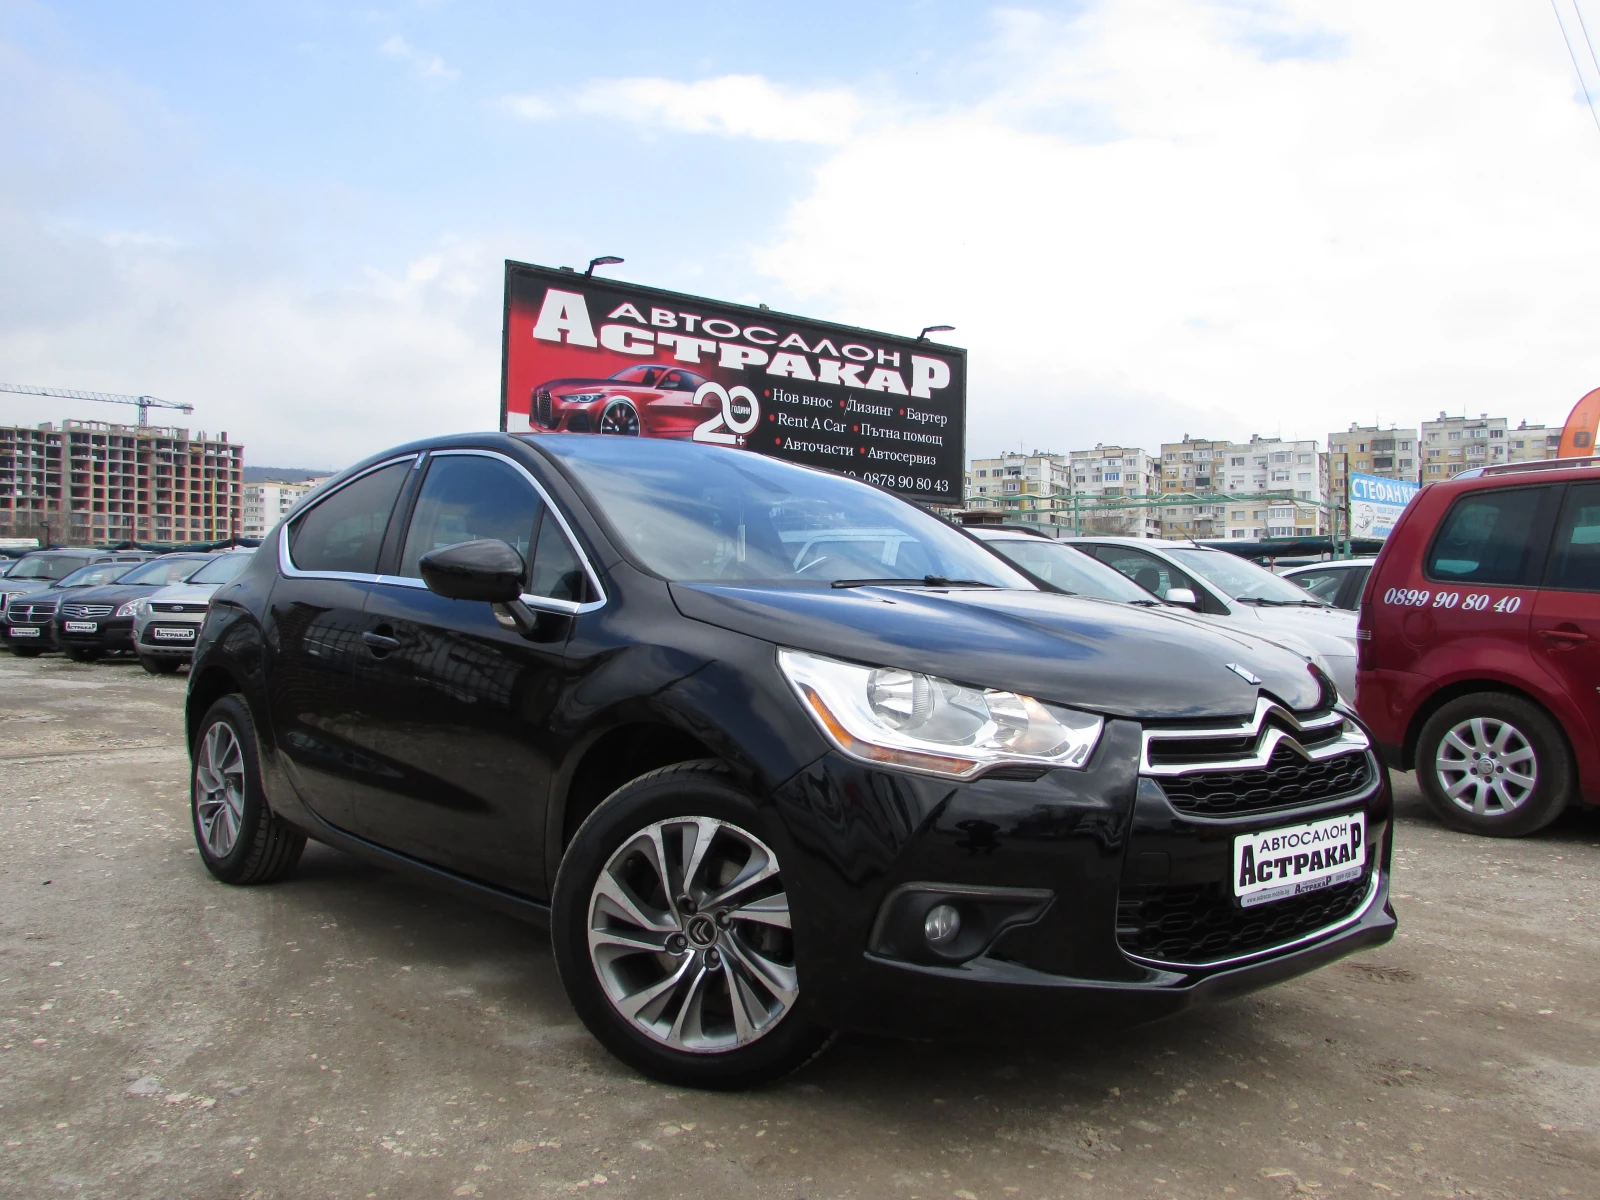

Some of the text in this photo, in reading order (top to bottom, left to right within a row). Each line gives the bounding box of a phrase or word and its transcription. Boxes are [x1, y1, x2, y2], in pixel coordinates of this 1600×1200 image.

[607, 302, 900, 367] АВТОСАЛОН
[772, 388, 833, 409] Нов внос
[846, 399, 893, 417] Лизинг
[777, 412, 847, 433] Rent A Car
[906, 407, 948, 428] Бартер
[860, 423, 943, 447] Пътна помощ
[783, 437, 854, 457] Авточасти
[867, 446, 937, 466] Автосервиз
[863, 472, 896, 487] 0878
[898, 475, 914, 490] 90
[916, 478, 932, 491] 80
[933, 480, 949, 492] 43
[1351, 478, 1402, 504] СТЕФАН
[1383, 587, 1521, 613] 0899 90 80 40
[1259, 823, 1347, 854] АВТОСАЛОН
